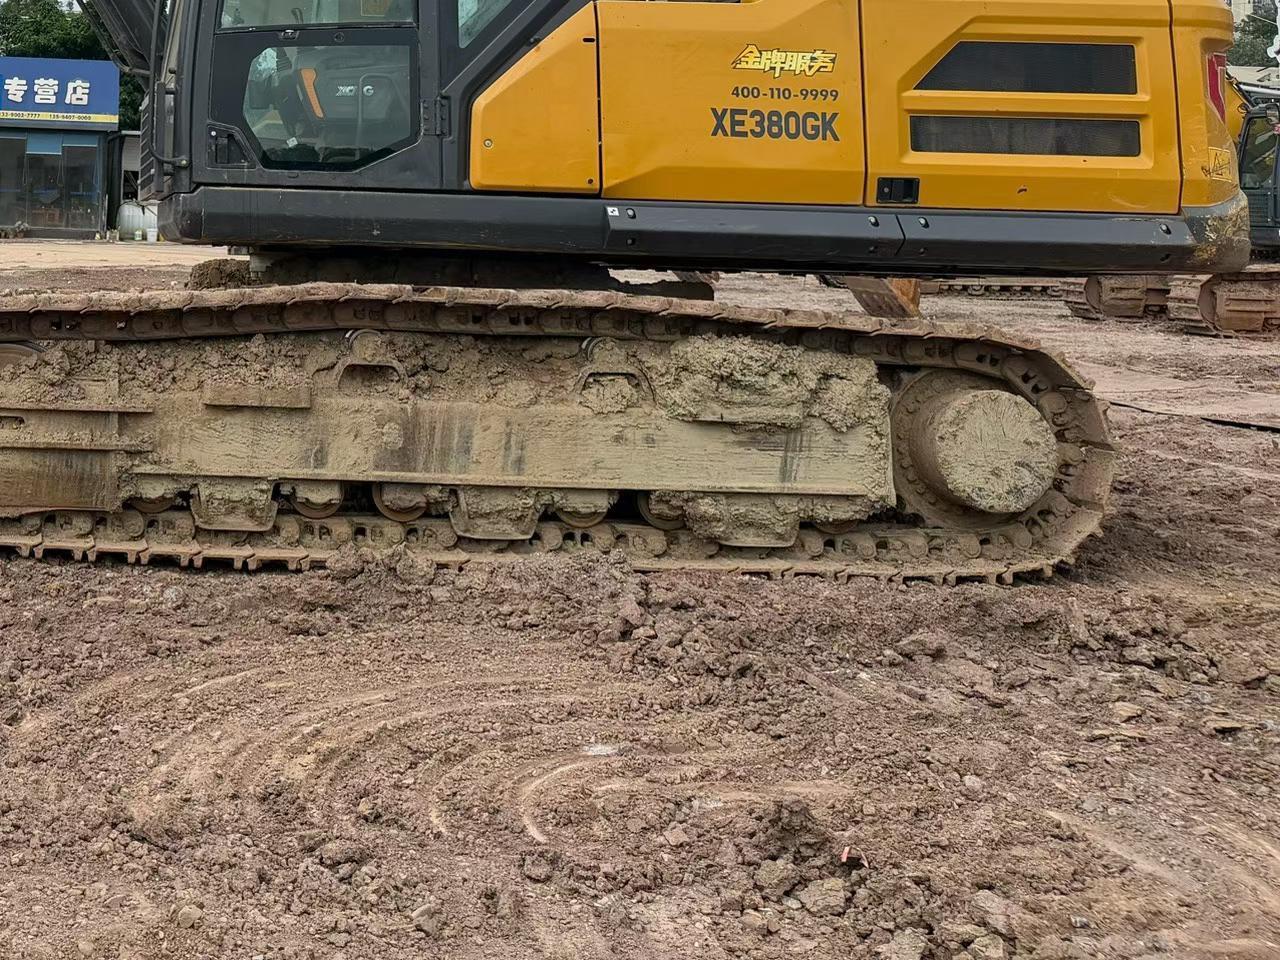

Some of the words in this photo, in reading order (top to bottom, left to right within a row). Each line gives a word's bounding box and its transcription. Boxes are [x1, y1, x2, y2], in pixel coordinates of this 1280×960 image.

[731, 44, 837, 78] 金牌服务
[731, 86, 839, 101] 400-110-9999
[710, 107, 840, 141] XE380GK
